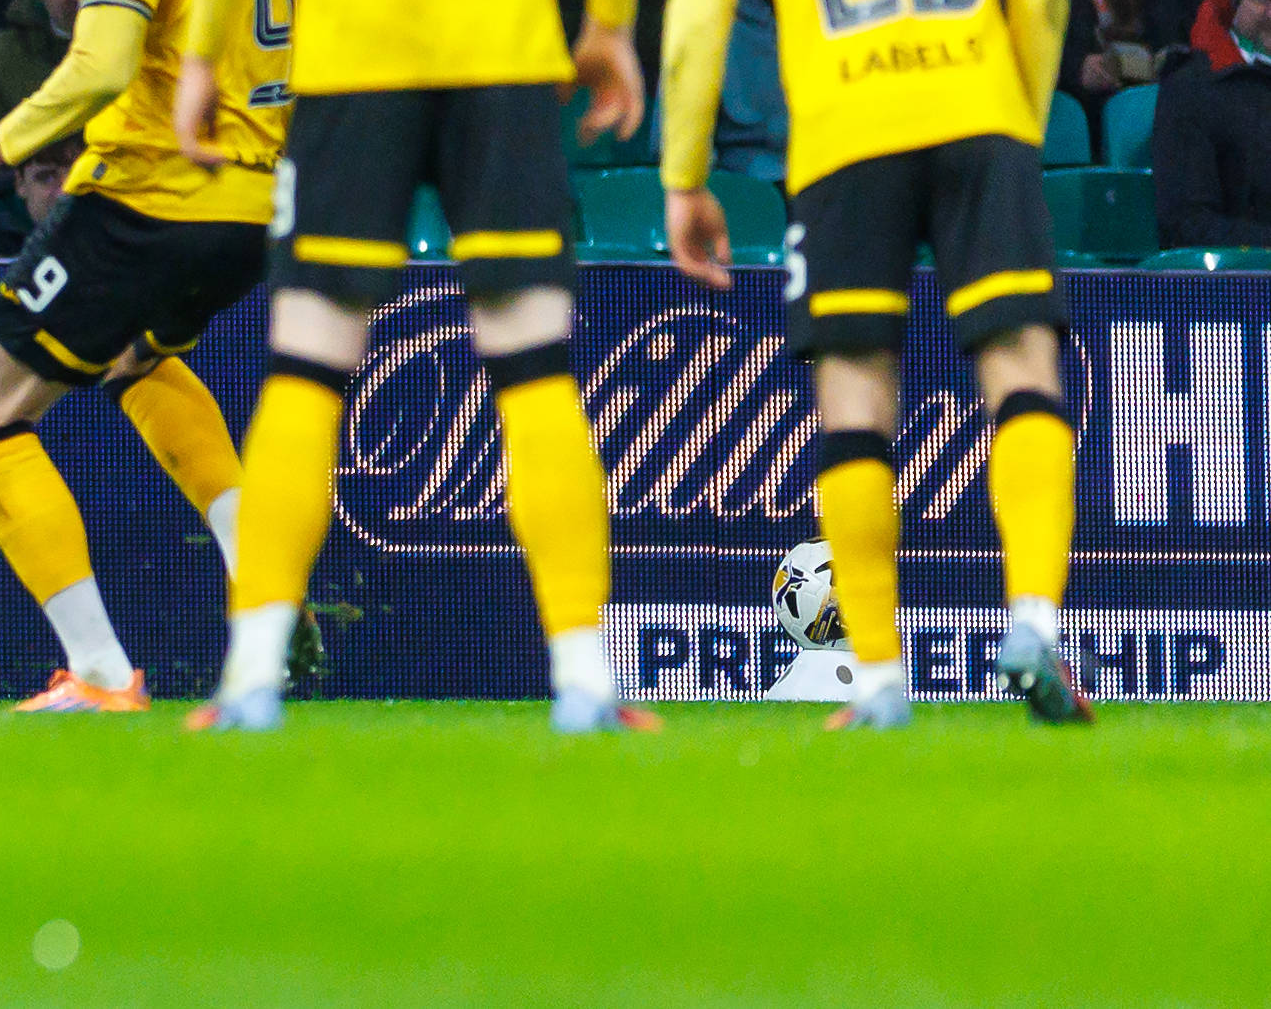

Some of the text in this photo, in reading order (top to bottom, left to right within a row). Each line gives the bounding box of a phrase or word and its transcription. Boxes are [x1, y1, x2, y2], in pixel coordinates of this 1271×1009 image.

[840, 35, 984, 84] LABELS
[17, 256, 68, 312] 9
[639, 626, 1221, 693] PREERHIP
